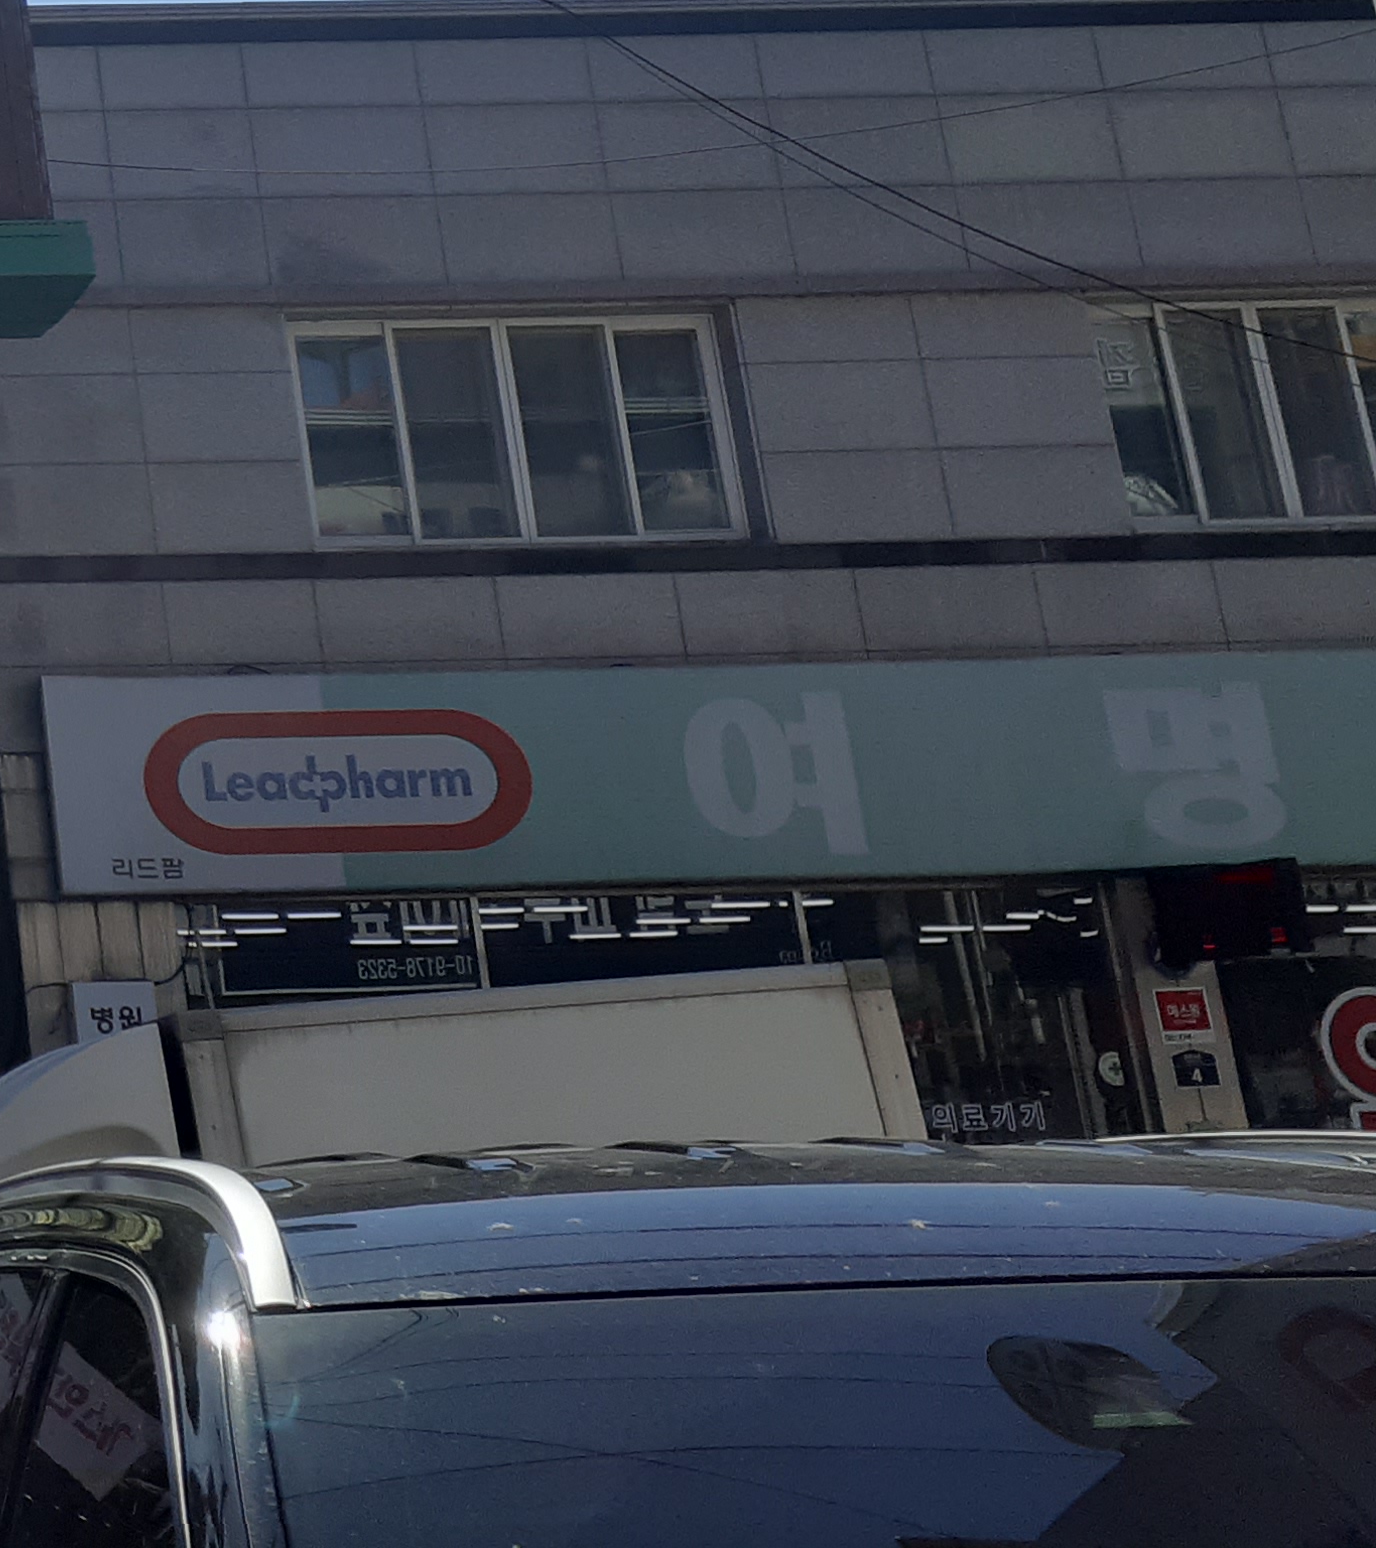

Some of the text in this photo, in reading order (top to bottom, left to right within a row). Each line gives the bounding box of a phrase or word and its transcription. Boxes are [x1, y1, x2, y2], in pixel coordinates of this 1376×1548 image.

[201, 754, 473, 813] Leadpharm
[111, 858, 185, 881] 리드팜
[90, 1006, 142, 1034] 병원
[931, 1100, 1048, 1134] 의료기기
